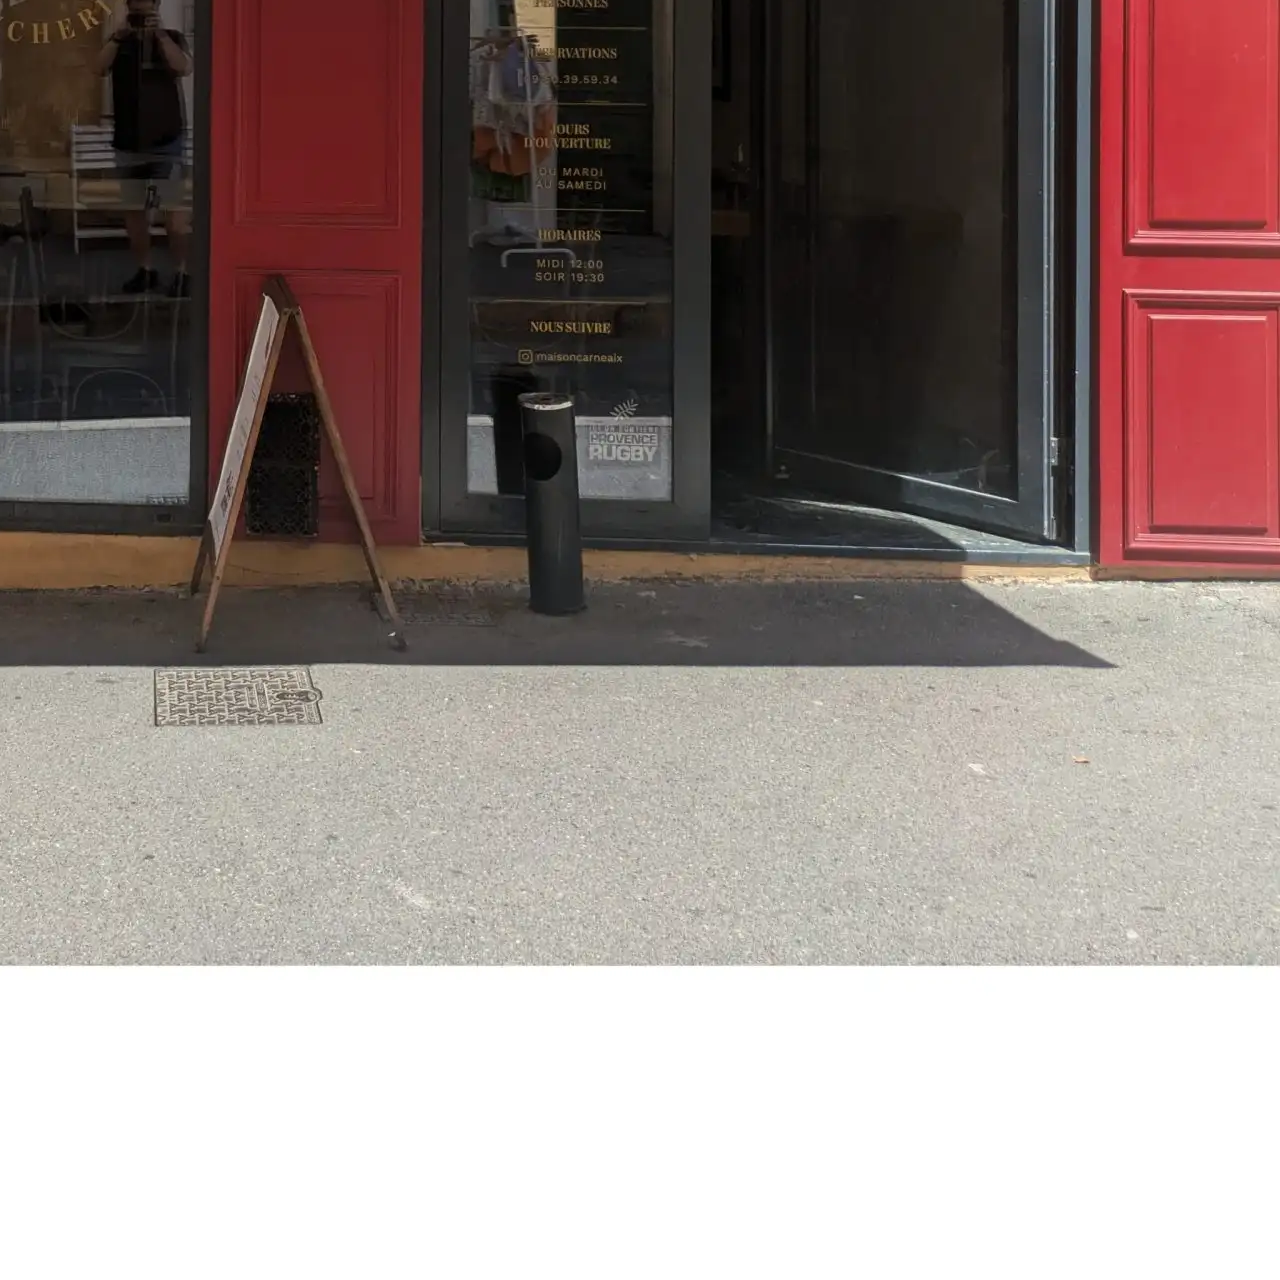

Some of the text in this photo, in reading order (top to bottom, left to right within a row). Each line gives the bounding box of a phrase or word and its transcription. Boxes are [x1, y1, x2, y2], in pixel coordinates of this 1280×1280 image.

[551, 124, 591, 135] JOURS
[524, 137, 612, 149] D'OUVERTURE
[562, 167, 604, 177] MARDI
[558, 180, 607, 190] SAMEDI
[538, 228, 602, 241] HORAIRES
[535, 259, 604, 269] MIDI 12:00
[535, 272, 605, 283] SOIR 19:30
[530, 321, 612, 334] NOUS SUIVRE
[535, 352, 623, 363] maisoncarneaix
[590, 433, 657, 444] PROVENCE
[589, 445, 657, 462] RUGBY
